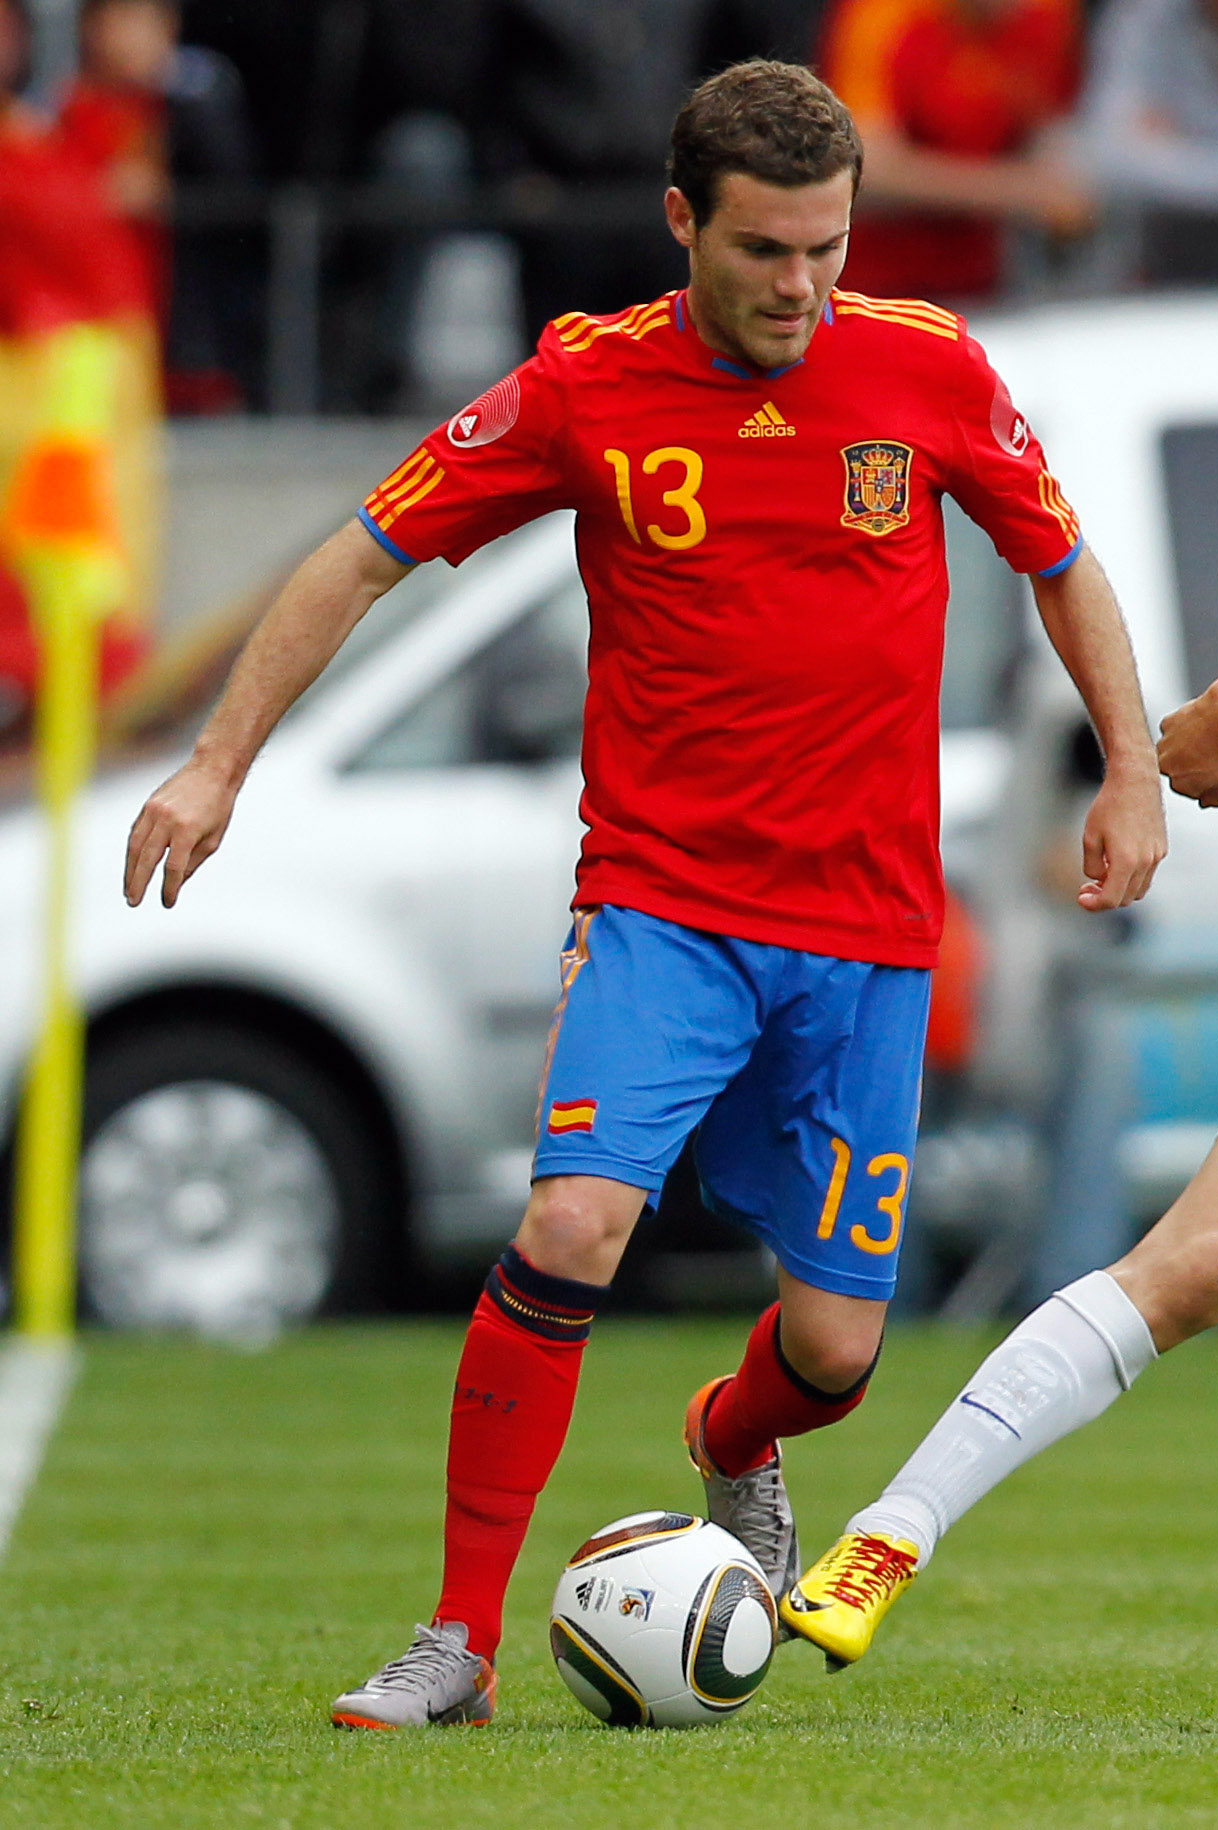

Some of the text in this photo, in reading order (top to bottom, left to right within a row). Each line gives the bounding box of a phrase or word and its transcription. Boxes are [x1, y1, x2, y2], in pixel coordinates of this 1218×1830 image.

[738, 425, 797, 438] adidas
[603, 446, 707, 551] 13
[817, 1137, 909, 1255] 13
[582, 1576, 598, 1612] adidas
